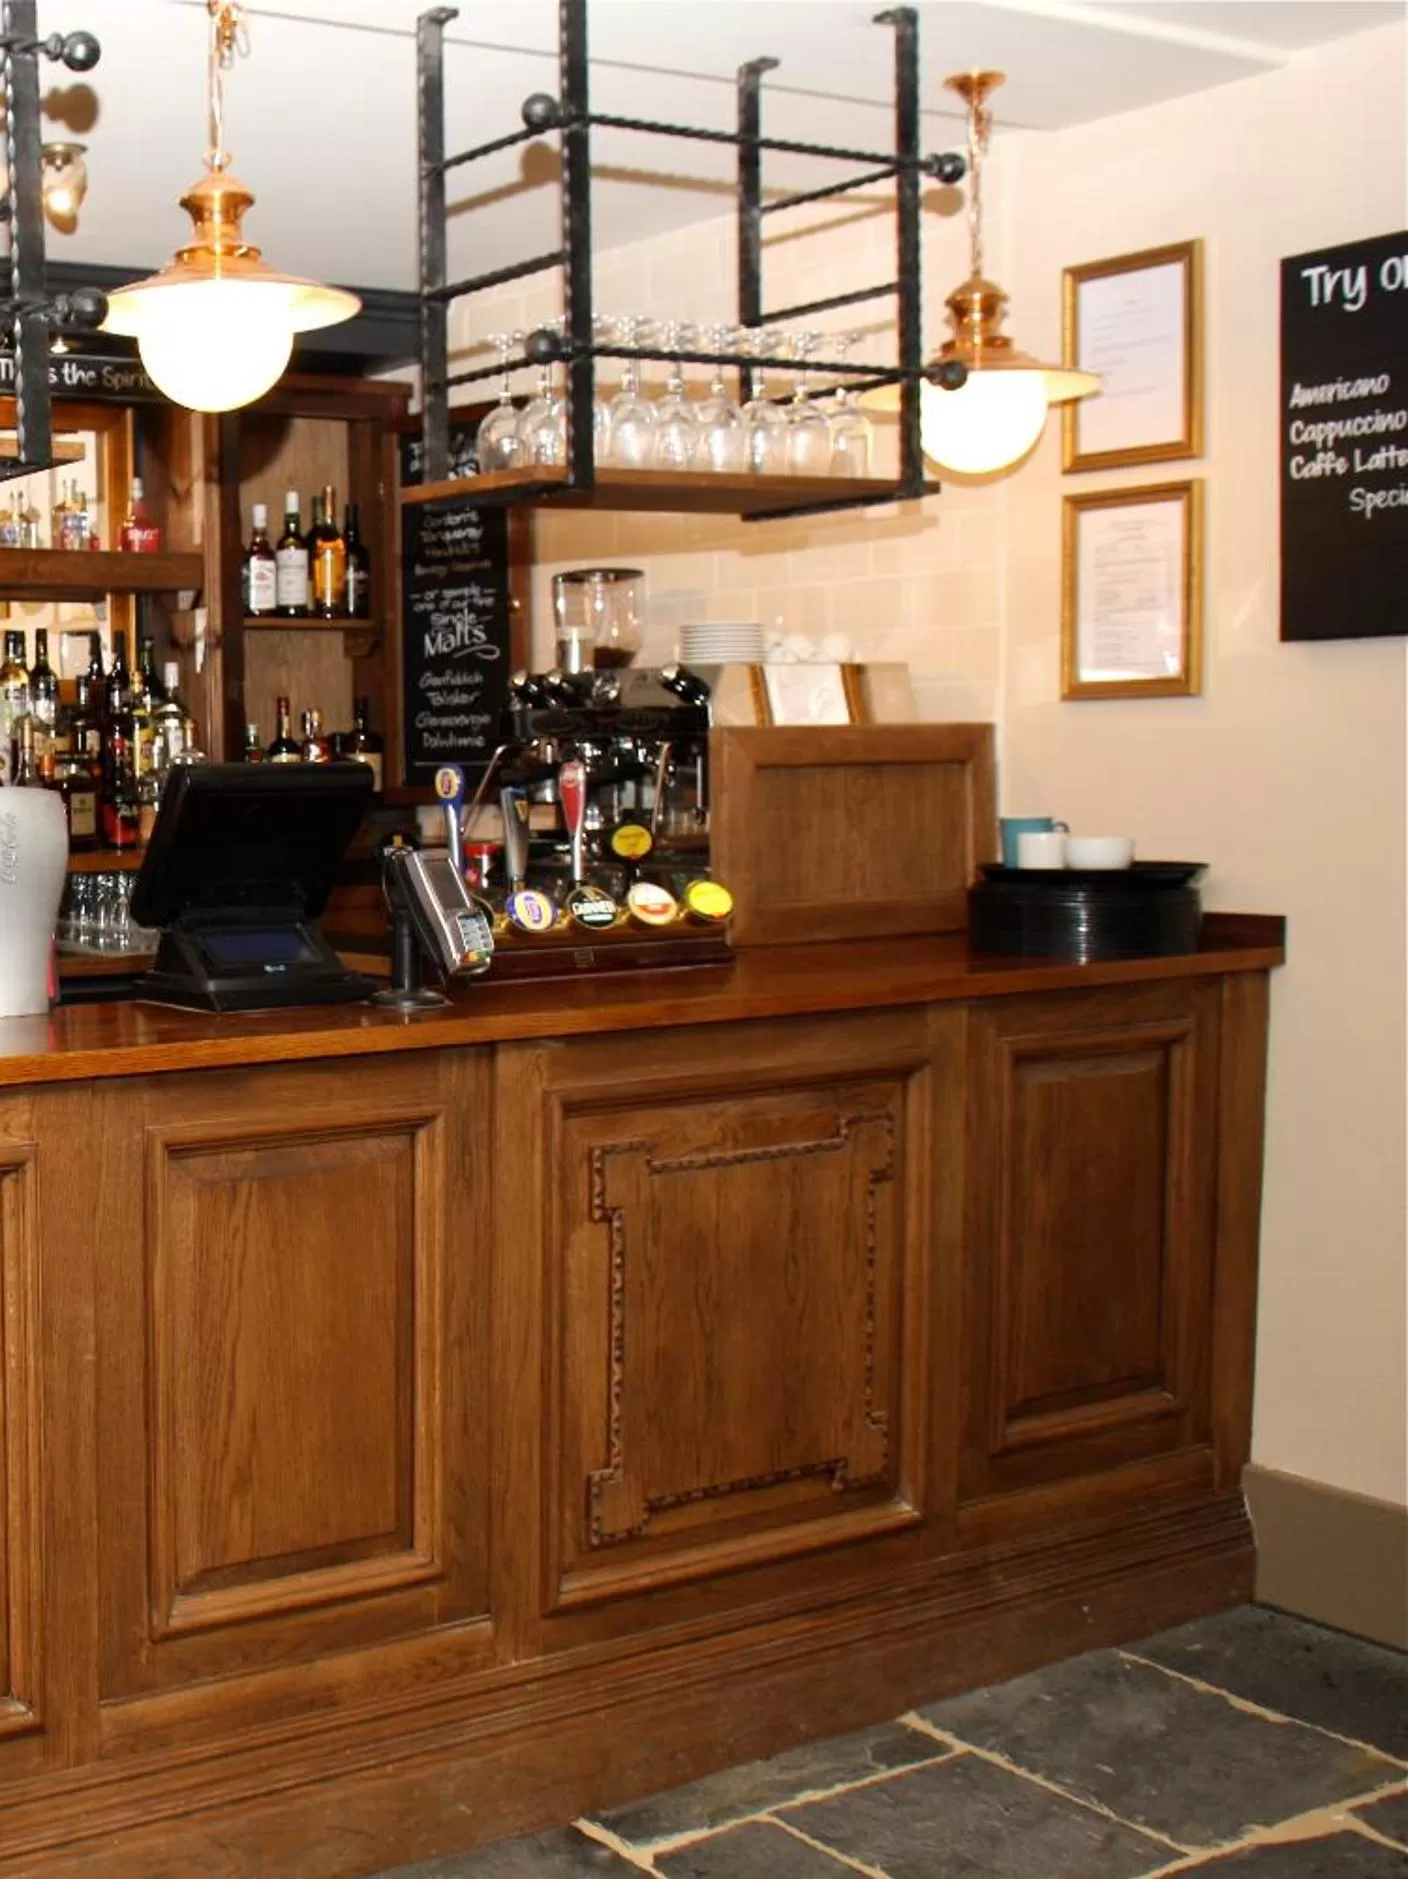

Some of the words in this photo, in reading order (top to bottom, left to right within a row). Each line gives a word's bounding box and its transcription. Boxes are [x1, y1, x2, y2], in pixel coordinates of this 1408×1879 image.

[1300, 263, 1367, 312] Try
[1289, 373, 1391, 409] Americano
[1289, 408, 1407, 450] Cappuccino
[1289, 450, 1349, 481] Caffe
[1349, 483, 1408, 519] Speci
[423, 607, 488, 660] Malts
